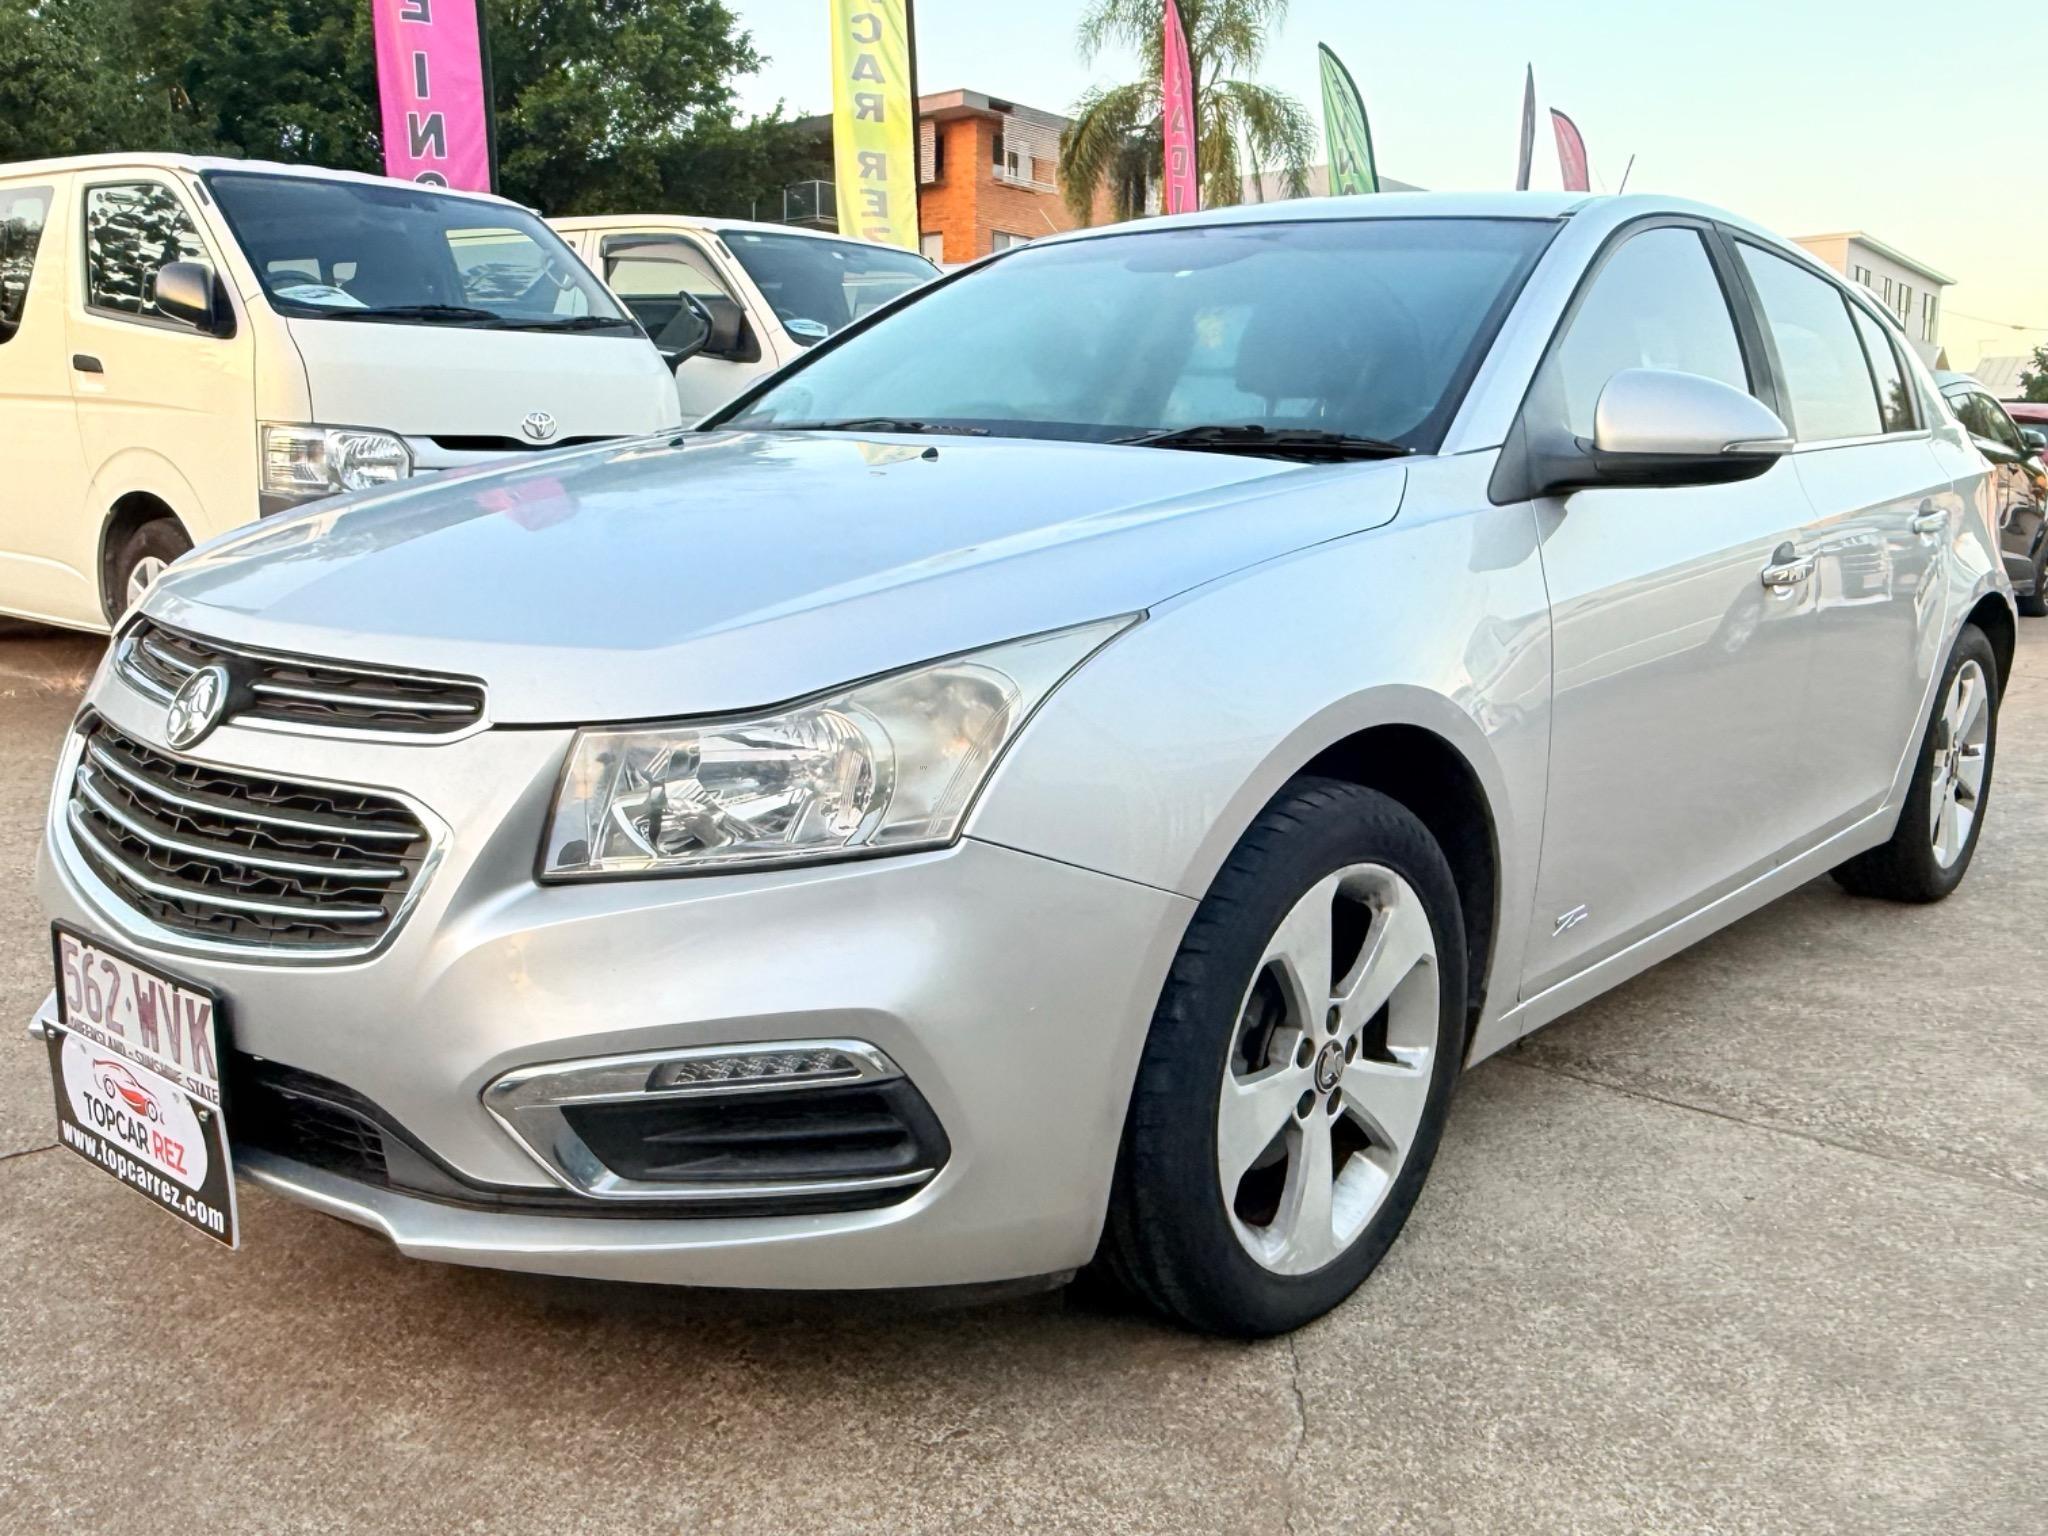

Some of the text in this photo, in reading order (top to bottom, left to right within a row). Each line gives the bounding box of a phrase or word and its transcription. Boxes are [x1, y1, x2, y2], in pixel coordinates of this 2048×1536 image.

[83, 1091, 188, 1176] TOPCAR REZ
[186, 1076, 219, 1106] STATE
[62, 1118, 225, 1235] www.topcarrez.com
